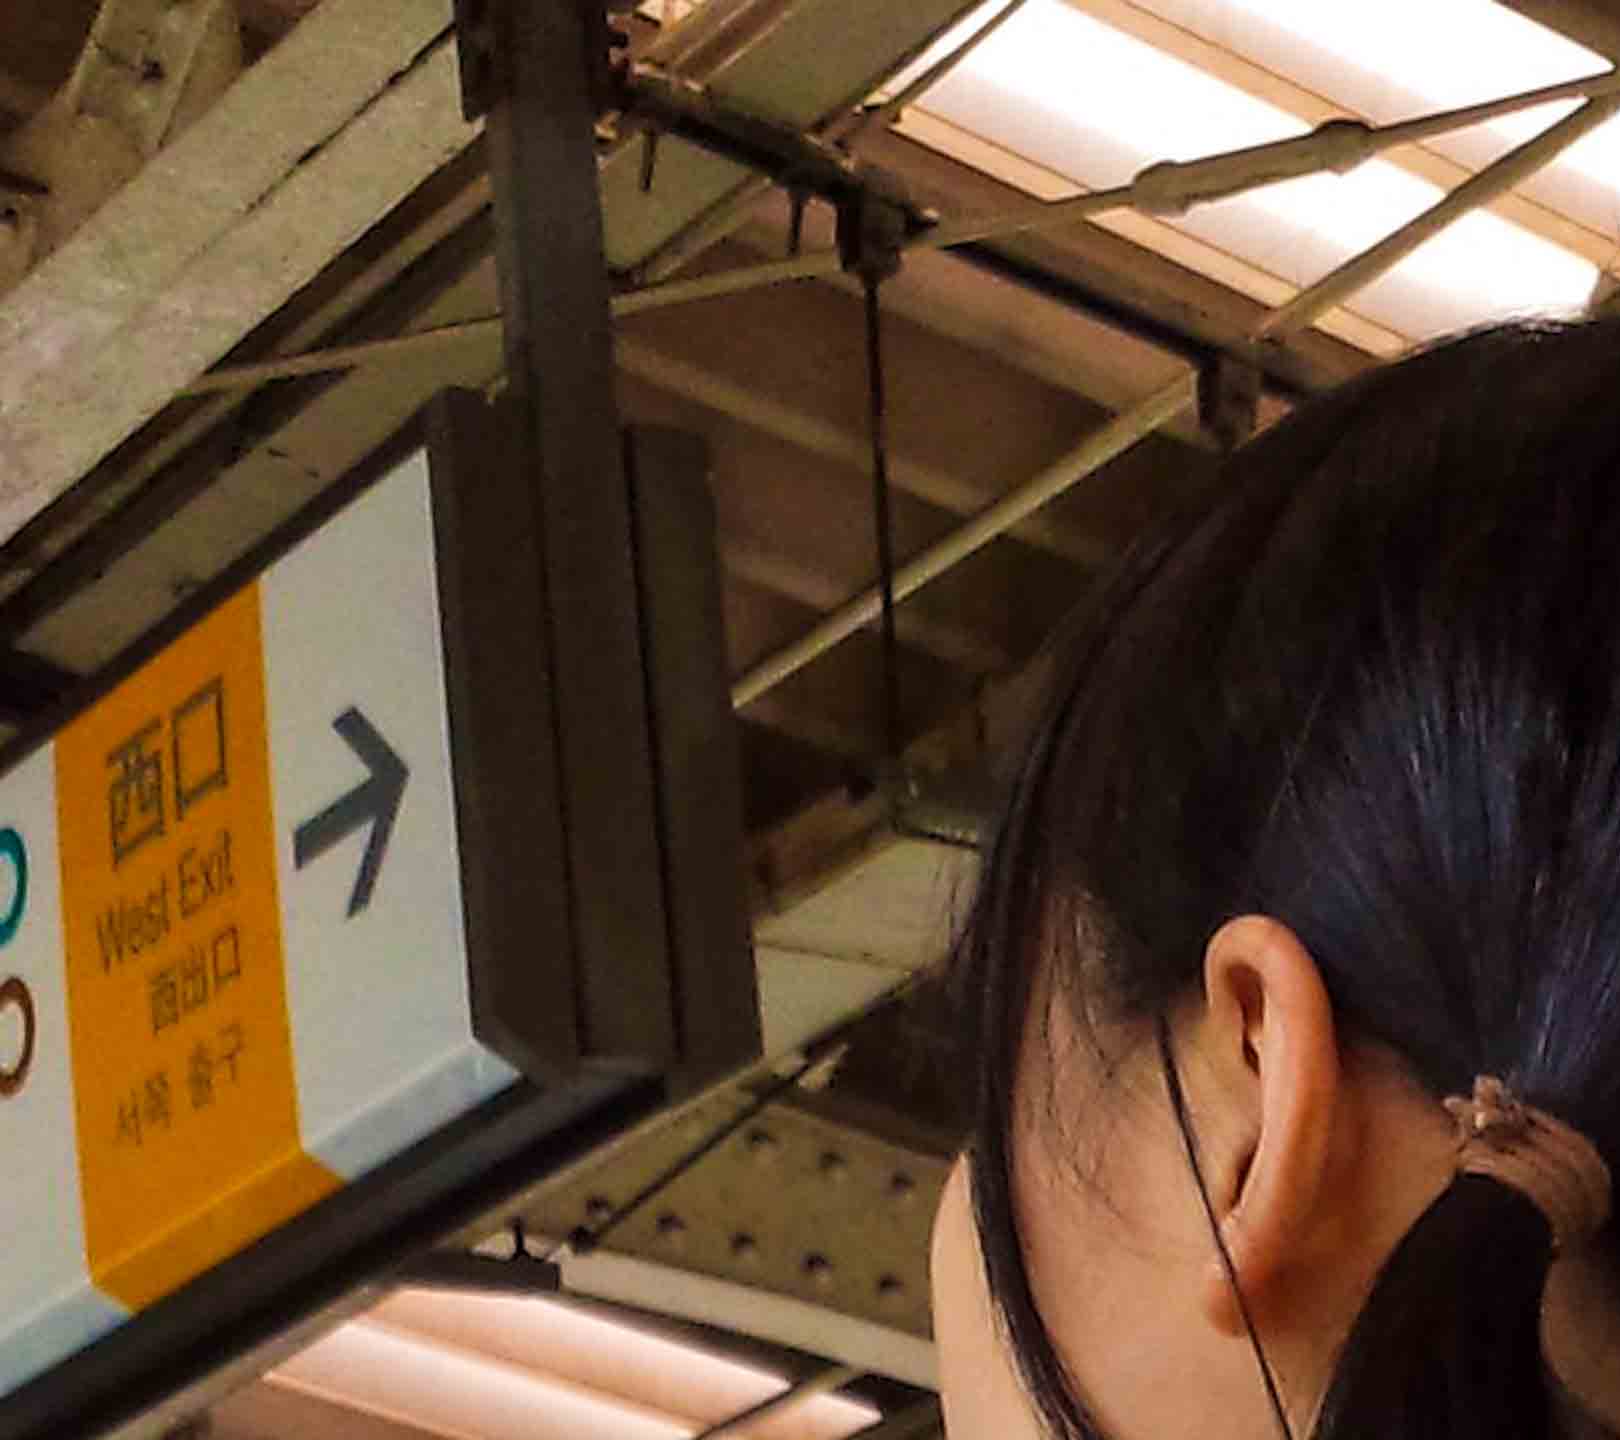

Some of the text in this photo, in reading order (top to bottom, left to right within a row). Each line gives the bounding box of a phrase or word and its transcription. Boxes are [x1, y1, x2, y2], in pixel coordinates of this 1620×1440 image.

[107, 677, 228, 868] 西口
[96, 829, 235, 974] West Exit
[149, 925, 242, 1035] 西出口
